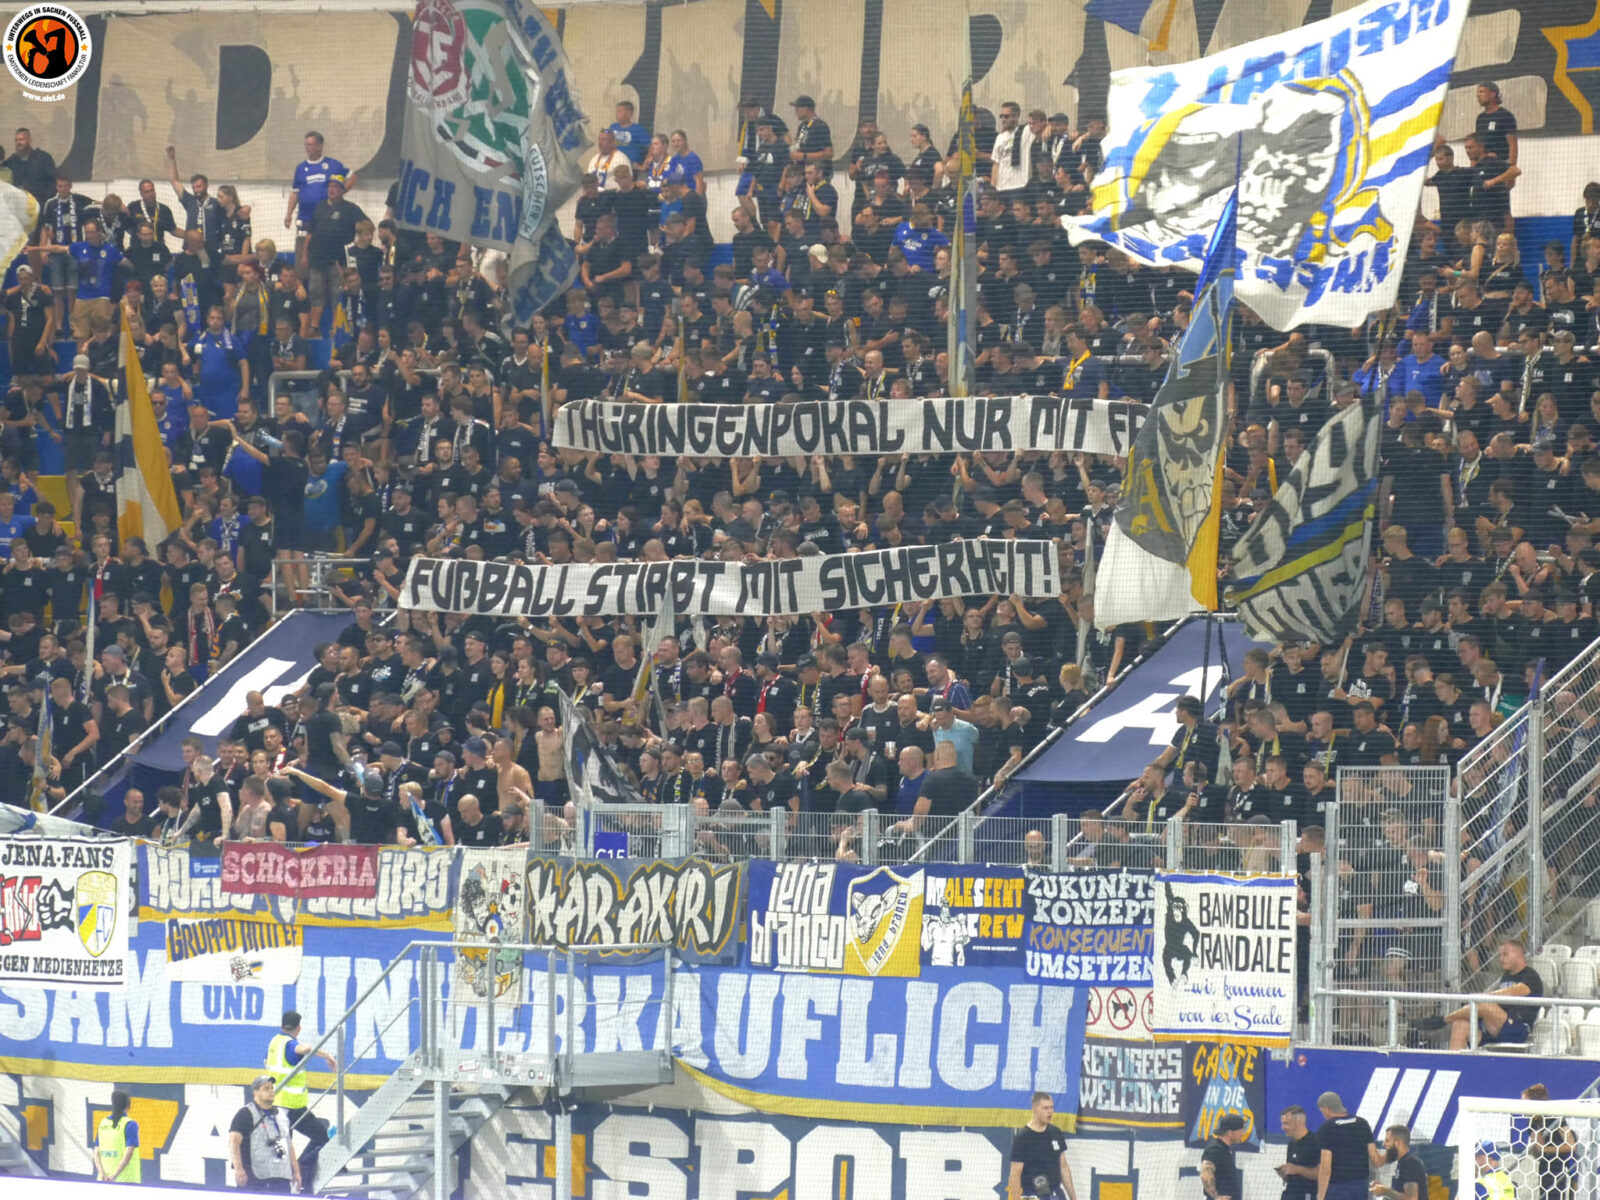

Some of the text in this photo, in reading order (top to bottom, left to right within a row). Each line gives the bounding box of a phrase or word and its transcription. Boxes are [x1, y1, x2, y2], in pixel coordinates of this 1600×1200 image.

[563, 399, 905, 456] THÜRINGENPOKAL
[922, 398, 1012, 451] NUR
[1029, 396, 1094, 450] MIT
[583, 560, 725, 615] STIRBT
[736, 558, 803, 614] MIT
[819, 540, 1051, 610] SICHERHEIT!
[222, 849, 377, 889] SCHICKERIA
[1199, 892, 1292, 931] BAMBULE
[168, 918, 237, 962] GRUPPO
[1029, 924, 1154, 956] KONSEQUENT
[1199, 932, 1292, 974] RANDALE
[33, 956, 123, 977] MEDIENHETZE
[1025, 950, 1154, 982] UMSETZEN
[203, 984, 264, 1022] UND
[1233, 1003, 1286, 1031] Saale
[1081, 1043, 1183, 1080] REFUGEES
[1080, 1076, 1182, 1114] WELCOME
[1205, 1084, 1246, 1108] IN DIE
